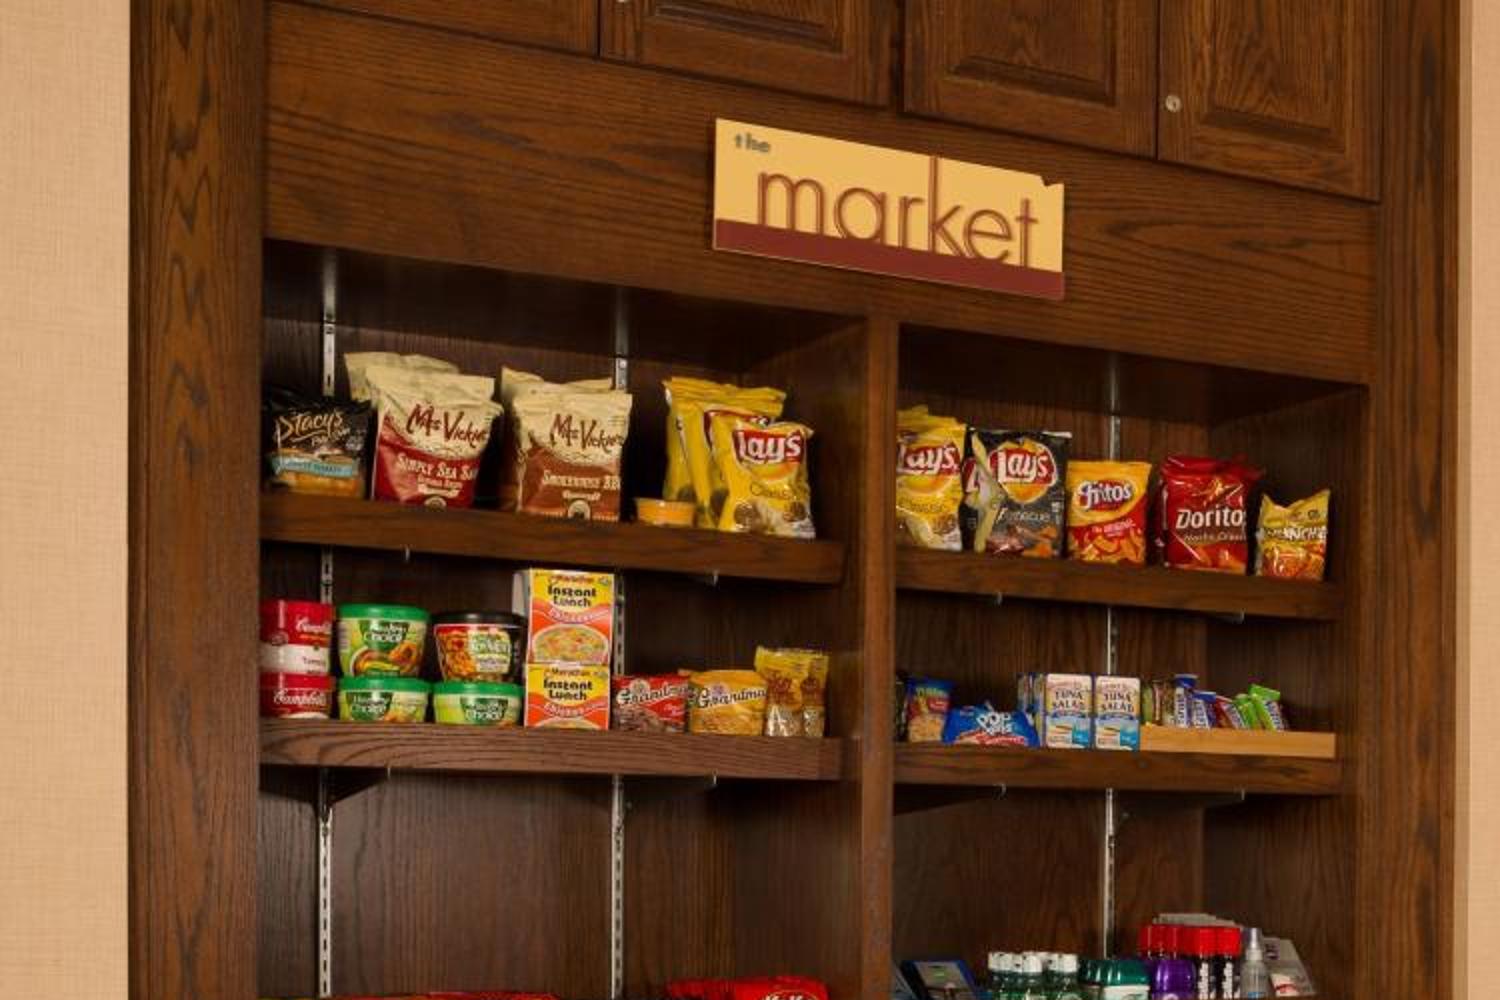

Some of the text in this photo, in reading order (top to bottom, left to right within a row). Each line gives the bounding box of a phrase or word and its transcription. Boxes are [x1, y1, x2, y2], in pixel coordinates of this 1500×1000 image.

[735, 132, 771, 153] the
[759, 155, 1039, 269] market
[548, 585, 597, 597] Instant
[553, 596, 591, 607] Lunch
[544, 679, 592, 691] Instant
[549, 690, 588, 701] Lunch
[1055, 690, 1083, 701] TUNA
[1103, 692, 1132, 703] TUNA
[1052, 700, 1086, 710] SALAD
[1101, 703, 1135, 713] SALAD
